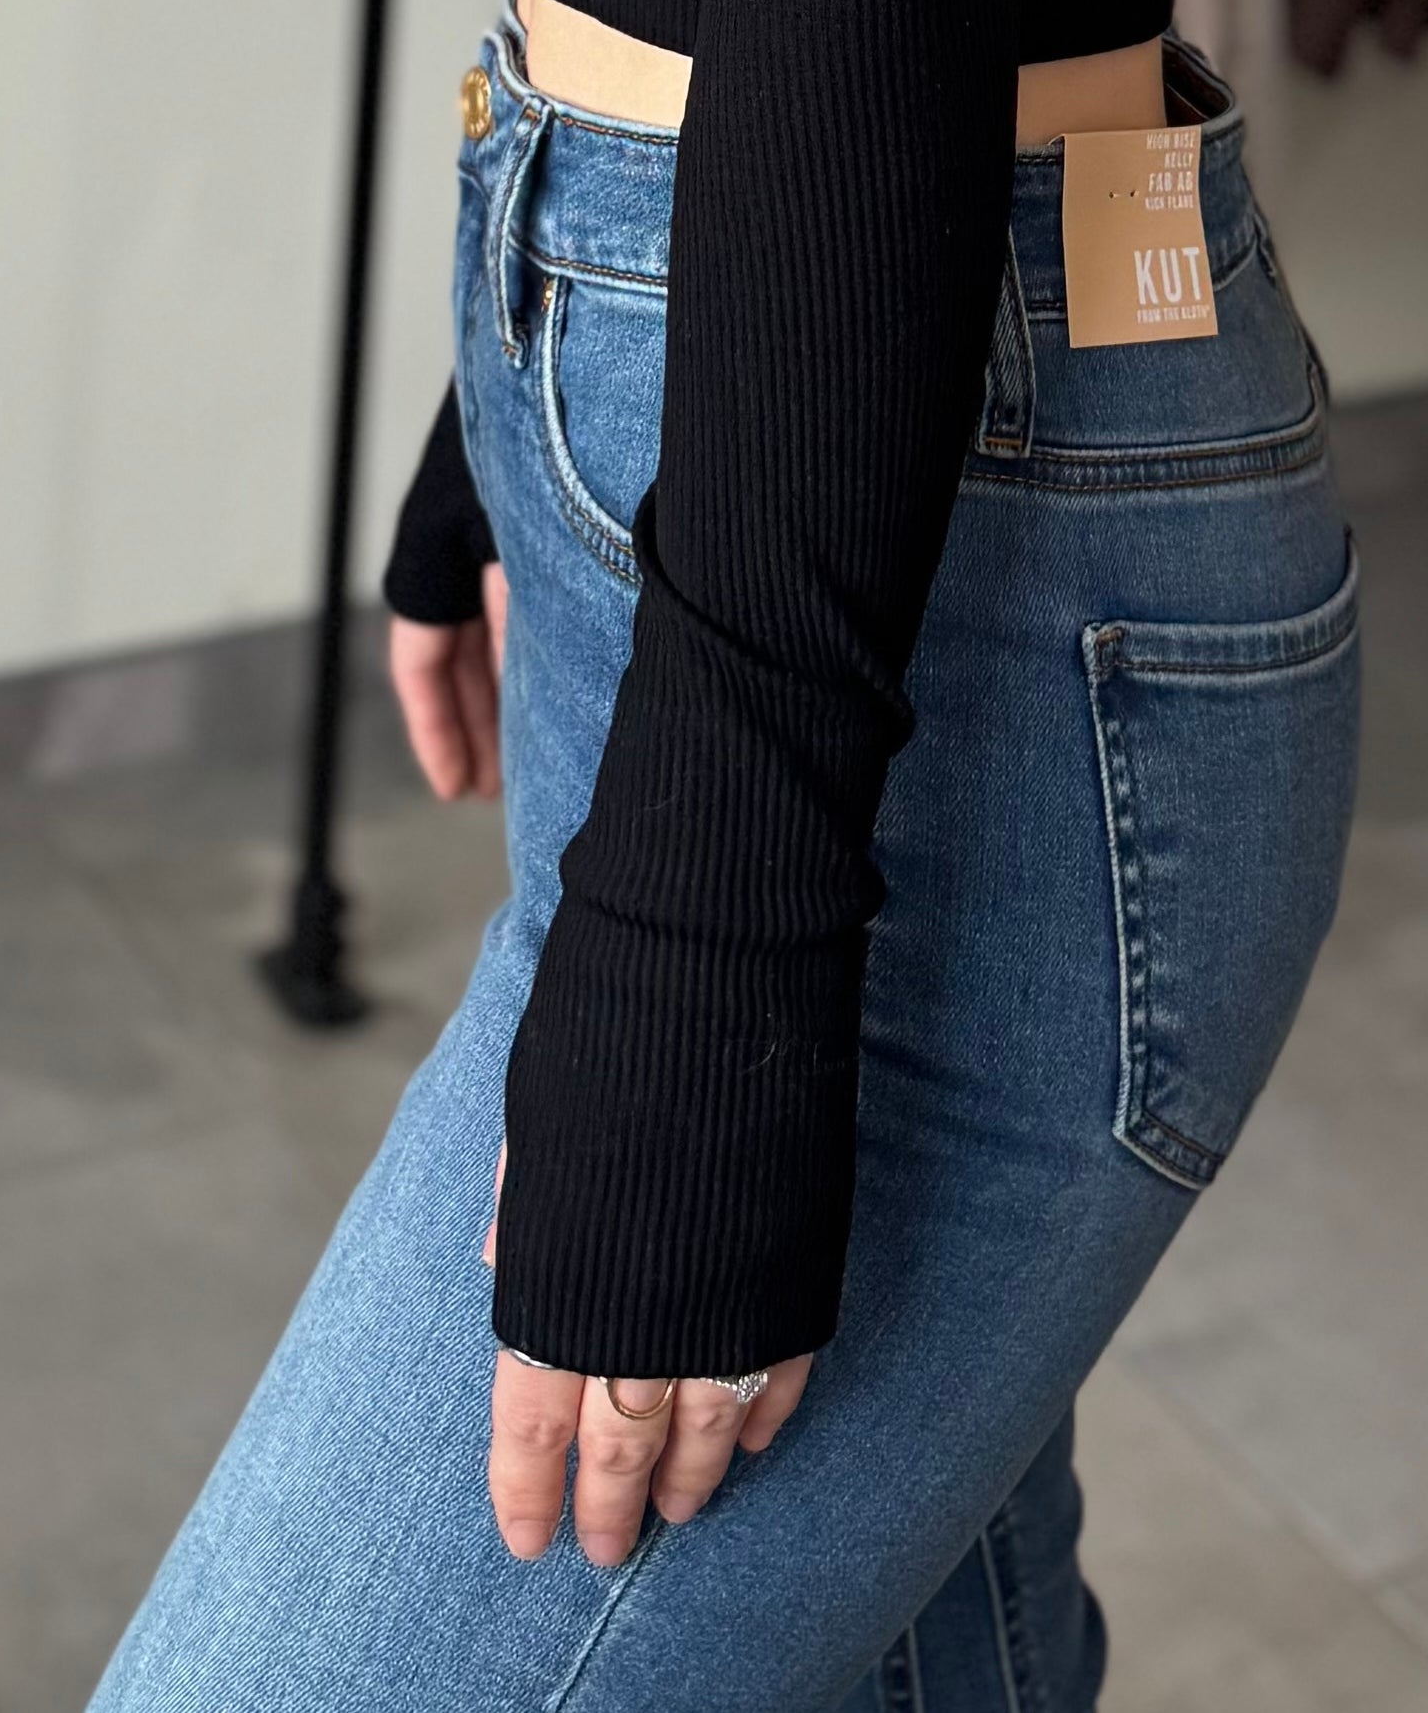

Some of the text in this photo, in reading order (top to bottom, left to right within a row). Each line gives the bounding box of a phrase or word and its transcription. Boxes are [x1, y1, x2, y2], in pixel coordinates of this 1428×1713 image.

[1148, 171, 1193, 192] FAB AB
[1134, 247, 1201, 305] KUT
[1136, 309, 1161, 324] FROM
[1163, 307, 1180, 322] THE
